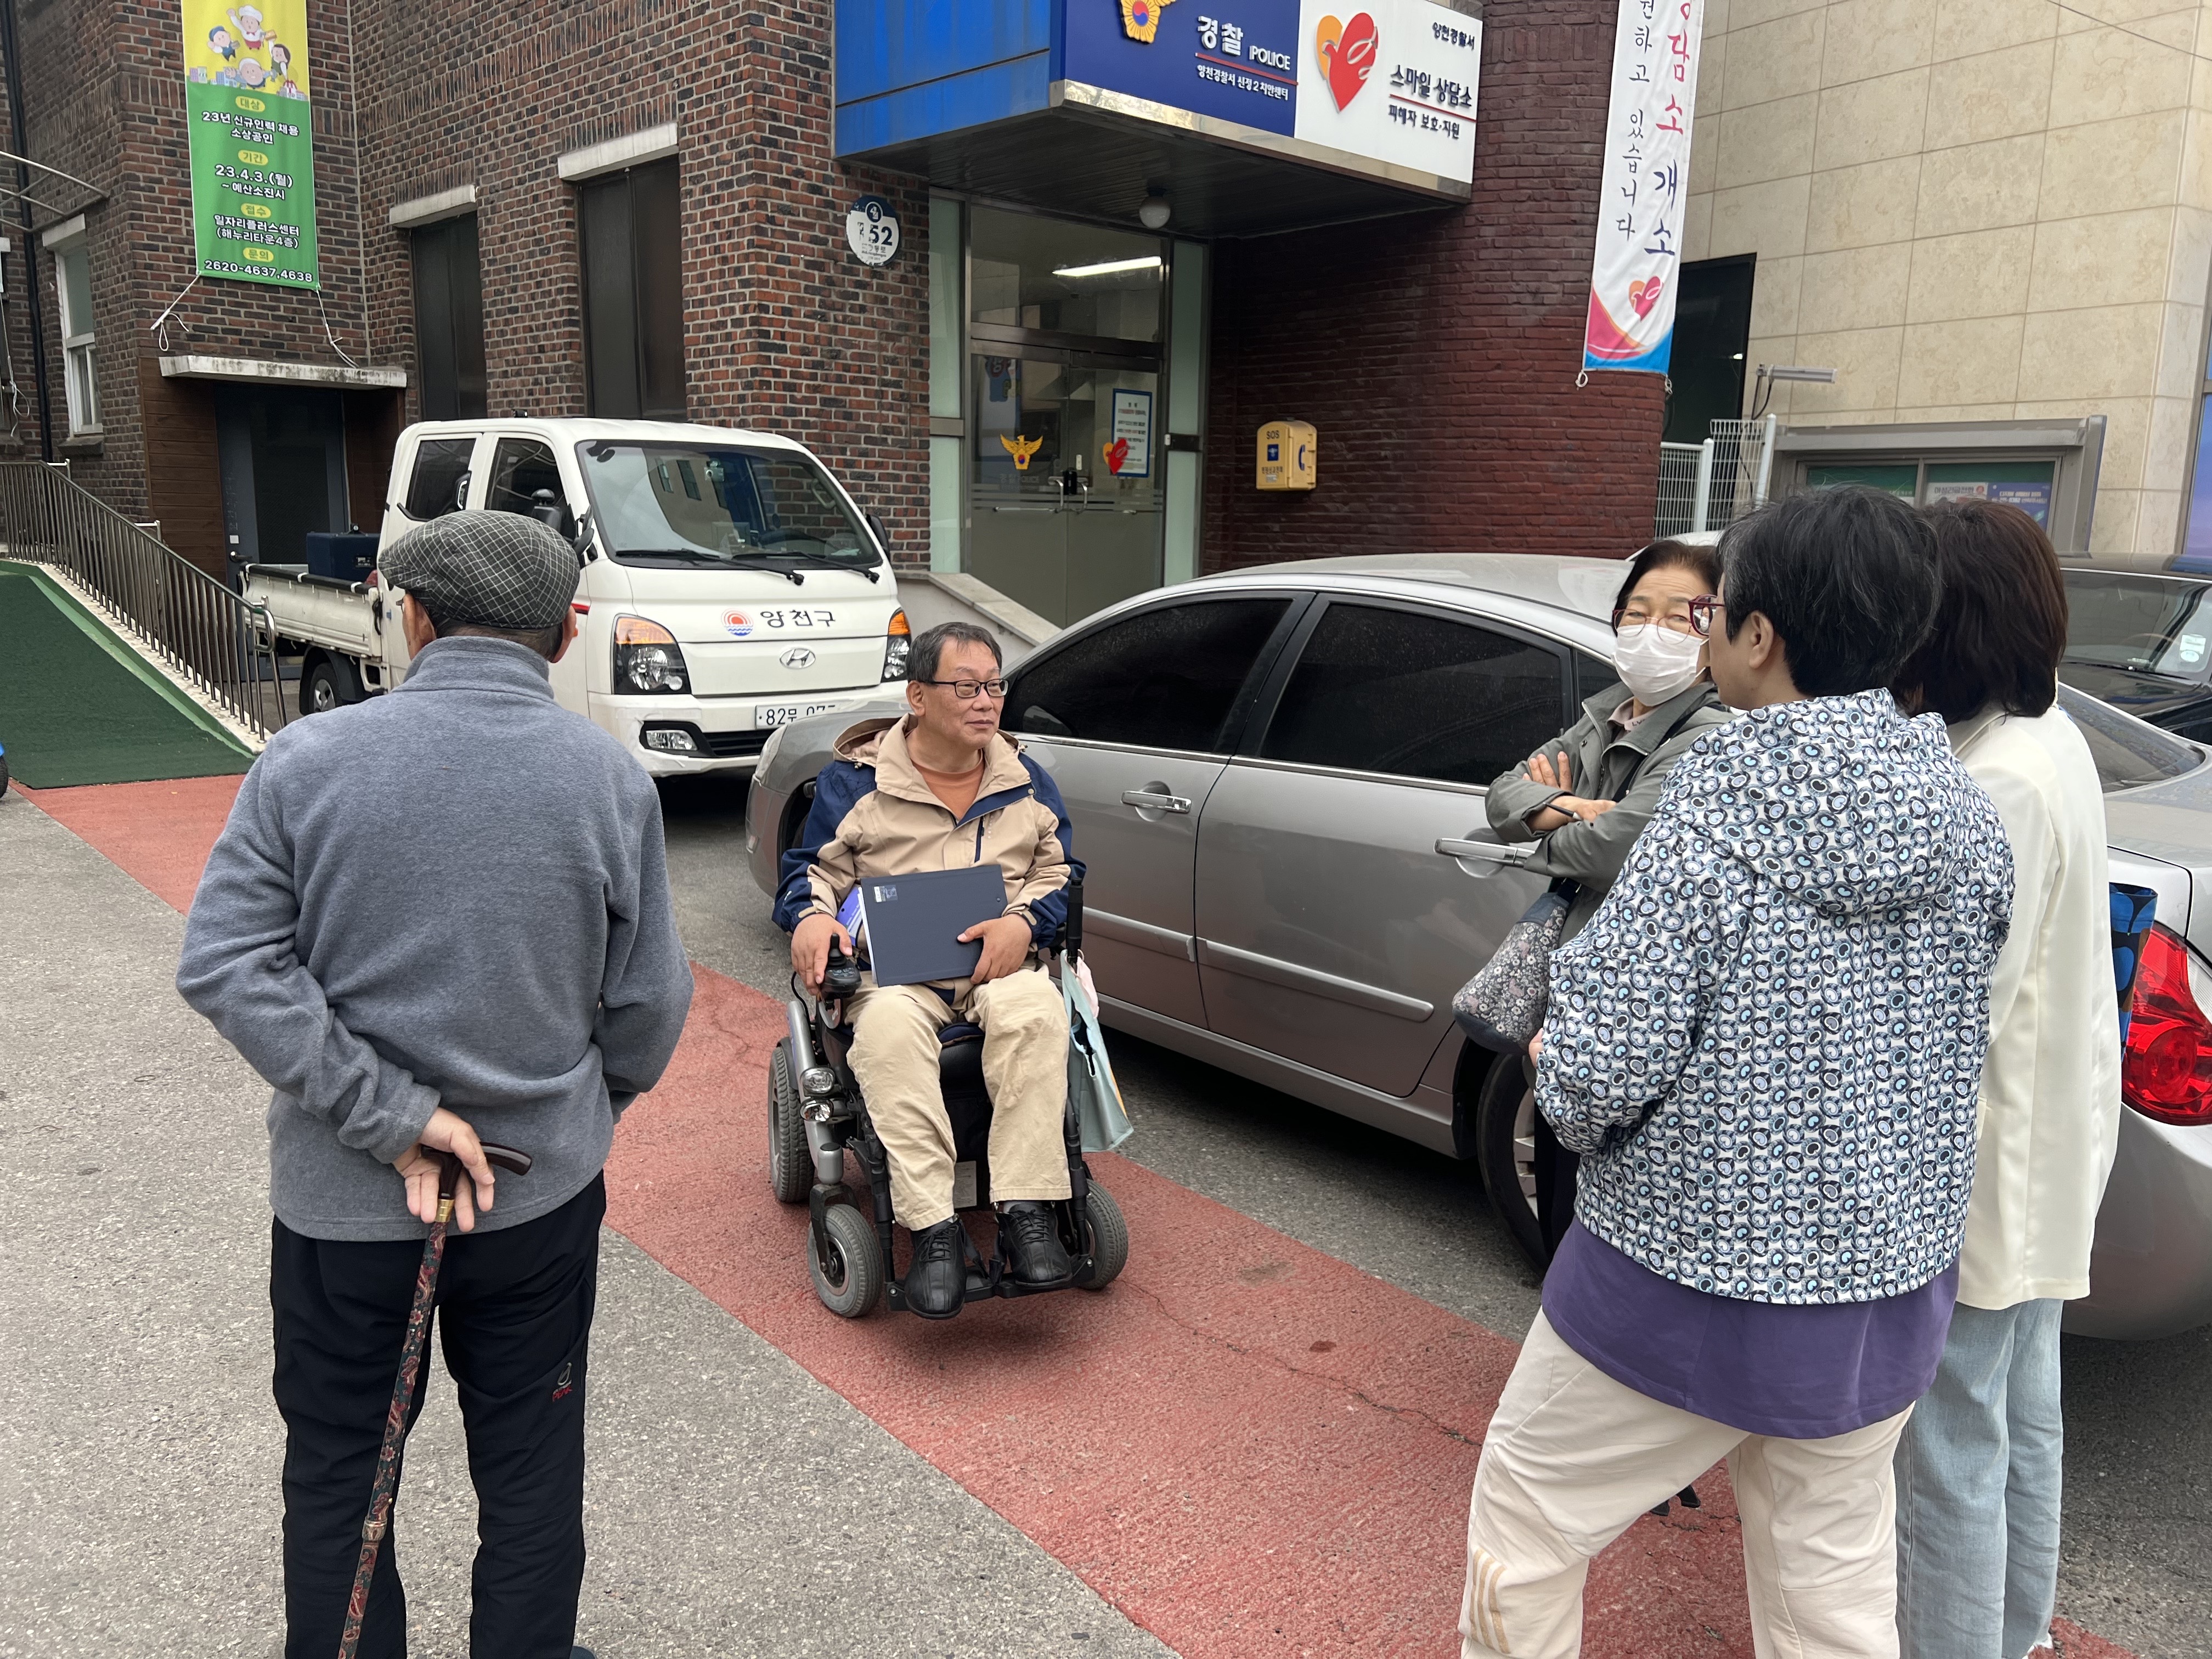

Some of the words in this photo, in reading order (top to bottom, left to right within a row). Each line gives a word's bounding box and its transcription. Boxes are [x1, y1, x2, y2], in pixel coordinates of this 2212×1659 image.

[1198, 16, 1244, 56] 경찰
[1432, 22, 1475, 50] 양천경찰서
[1249, 45, 1290, 71] POLICE
[1197, 64, 1235, 86] 양천경찰서
[1390, 65, 1431, 97] 스마일
[1434, 78, 1472, 107] 상담소
[240, 97, 260, 110] 대상
[202, 111, 232, 124] 23년
[233, 115, 276, 132] 신규인력
[278, 122, 300, 137] 채용
[1389, 104, 1417, 127] 피해자
[231, 128, 274, 144] 소상공인
[242, 151, 263, 164] 기간
[215, 165, 294, 188] 23.4.3.(월)
[1616, 109, 1644, 241] 있습니다
[232, 182, 285, 200] 예산소진시
[245, 204, 267, 217] 접수
[1644, 159, 1677, 256] 개소
[214, 214, 300, 236] 일자리플러스센터
[217, 227, 298, 249] (해누리타운4층)
[249, 249, 269, 261] 문의
[204, 259, 313, 282] 2620-4637,4638
[1266, 430, 1280, 439] SOS
[760, 609, 836, 628] 양천구
